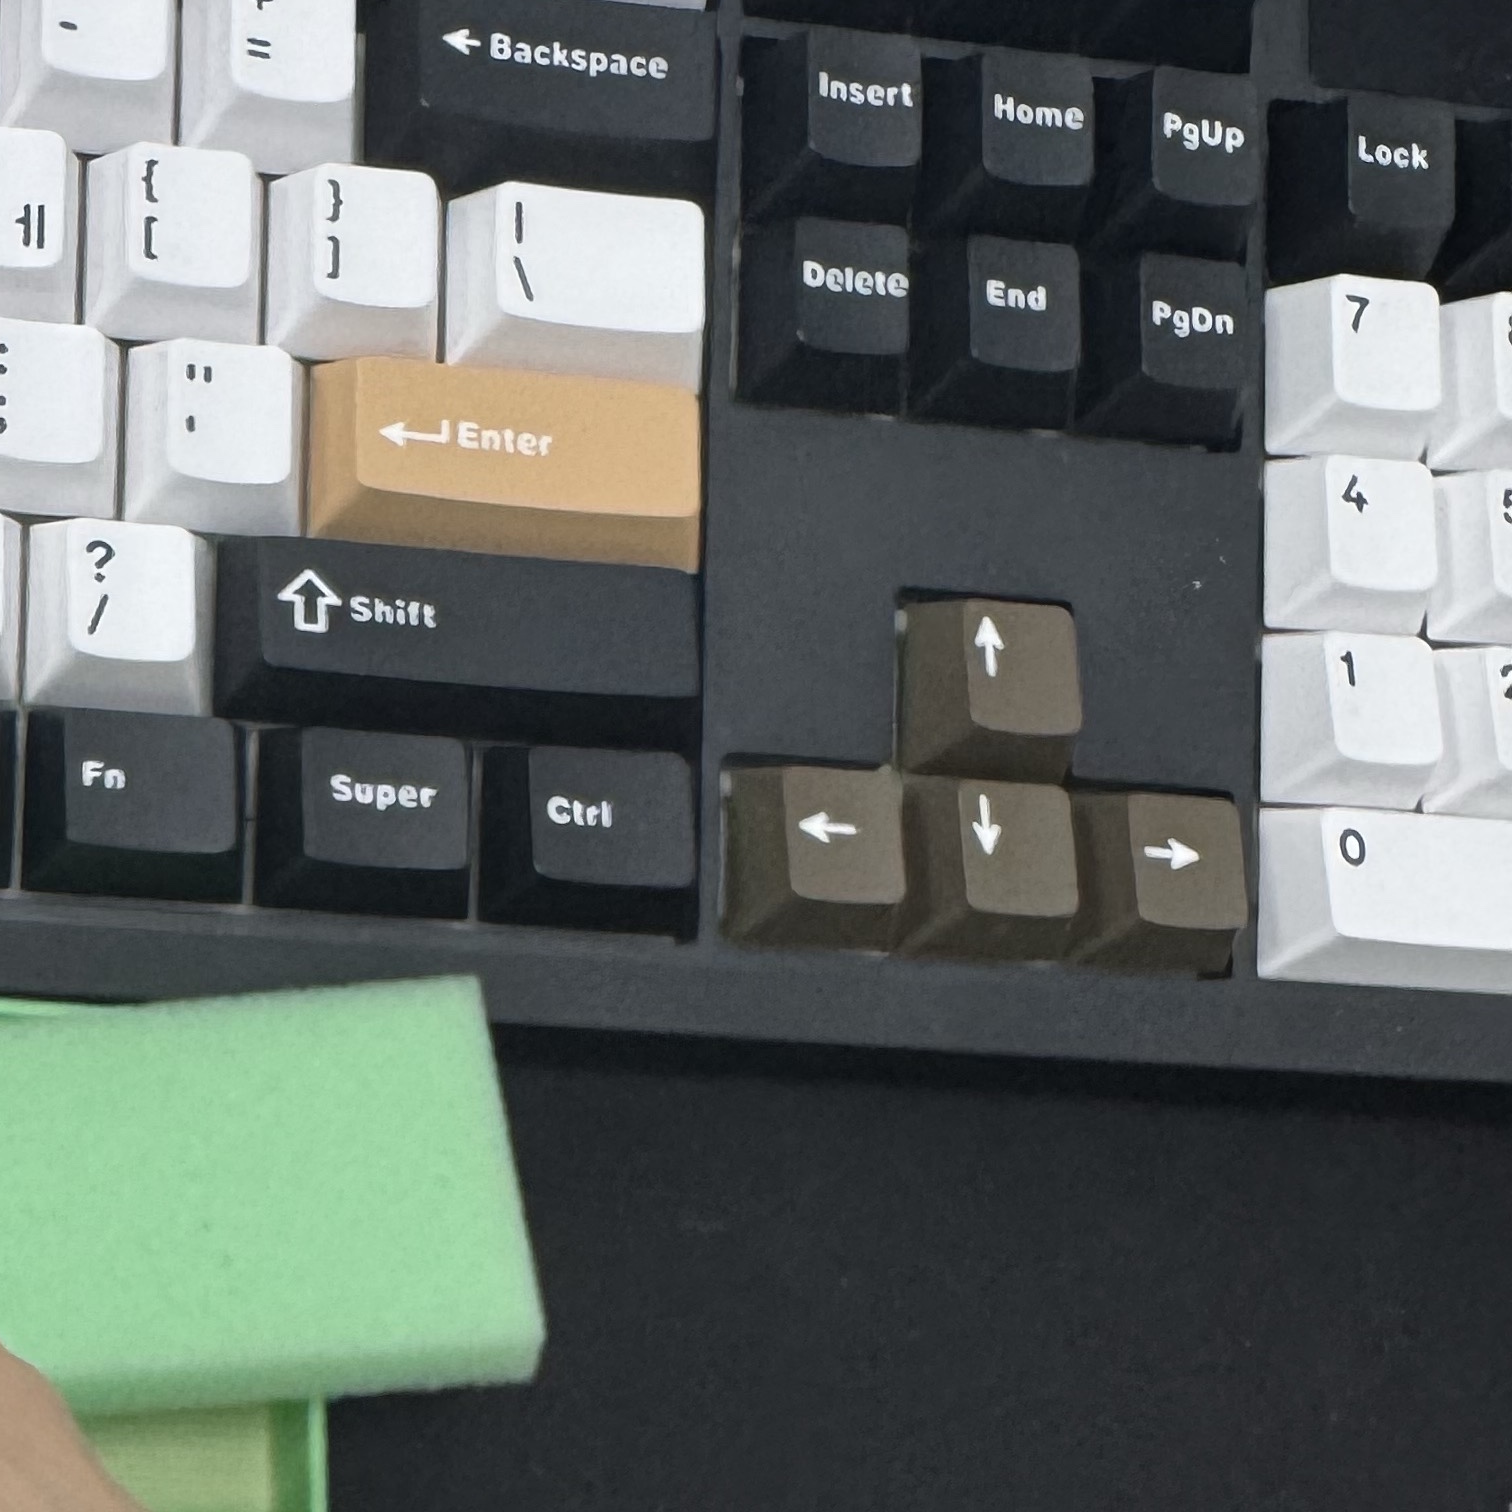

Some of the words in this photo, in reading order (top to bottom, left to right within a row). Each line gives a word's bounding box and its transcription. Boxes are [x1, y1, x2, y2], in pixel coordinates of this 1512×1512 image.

[246, 37, 272, 60] =
[489, 32, 669, 80] Backspace
[819, 71, 914, 108] Insert
[994, 93, 1085, 130] Home
[1163, 111, 1245, 154] PgUp
[1358, 135, 1429, 170] Lock
[141, 158, 159, 203] {
[325, 178, 344, 223] }
[14, 203, 45, 250] ㅔ
[143, 215, 159, 261] [
[326, 235, 340, 280] ]
[802, 260, 909, 298] Delete
[986, 279, 1047, 311] End
[1152, 300, 1234, 338] PgDn
[1345, 294, 1370, 334] 7
[457, 420, 553, 457] Enter
[1341, 474, 1369, 514] 4
[85, 539, 116, 583] ?
[87, 593, 109, 636] /
[349, 595, 437, 629] Shift
[1340, 650, 1356, 687] 1
[81, 760, 126, 789] Fn
[330, 774, 437, 811] Super
[546, 795, 612, 828] Ctrl
[1339, 828, 1366, 867] 0
